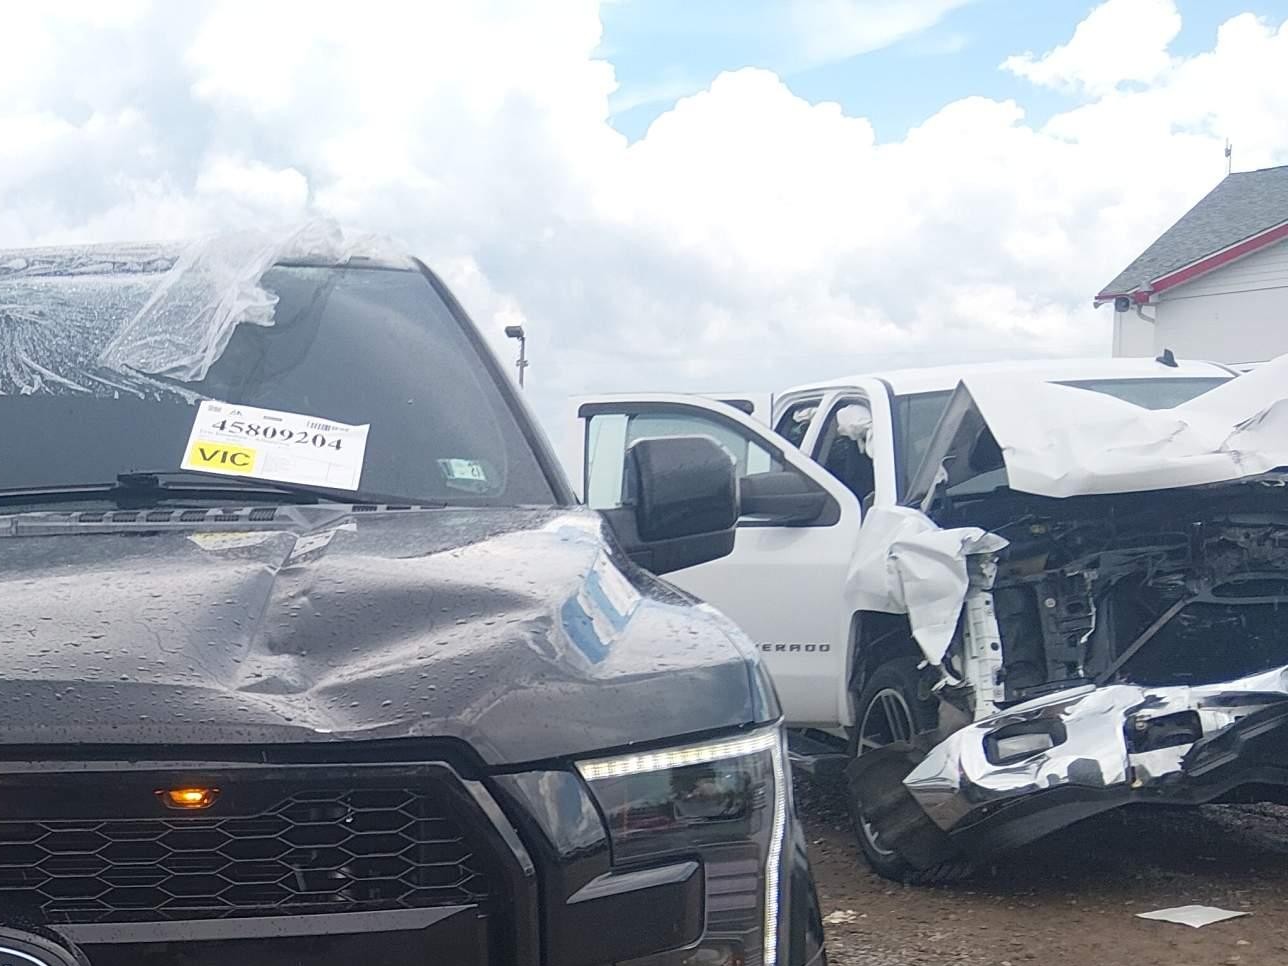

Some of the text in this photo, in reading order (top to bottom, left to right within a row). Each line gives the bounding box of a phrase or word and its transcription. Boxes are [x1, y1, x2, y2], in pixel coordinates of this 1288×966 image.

[211, 419, 343, 451] 45809204
[196, 447, 252, 467] VIC
[755, 643, 831, 652] ERADO
